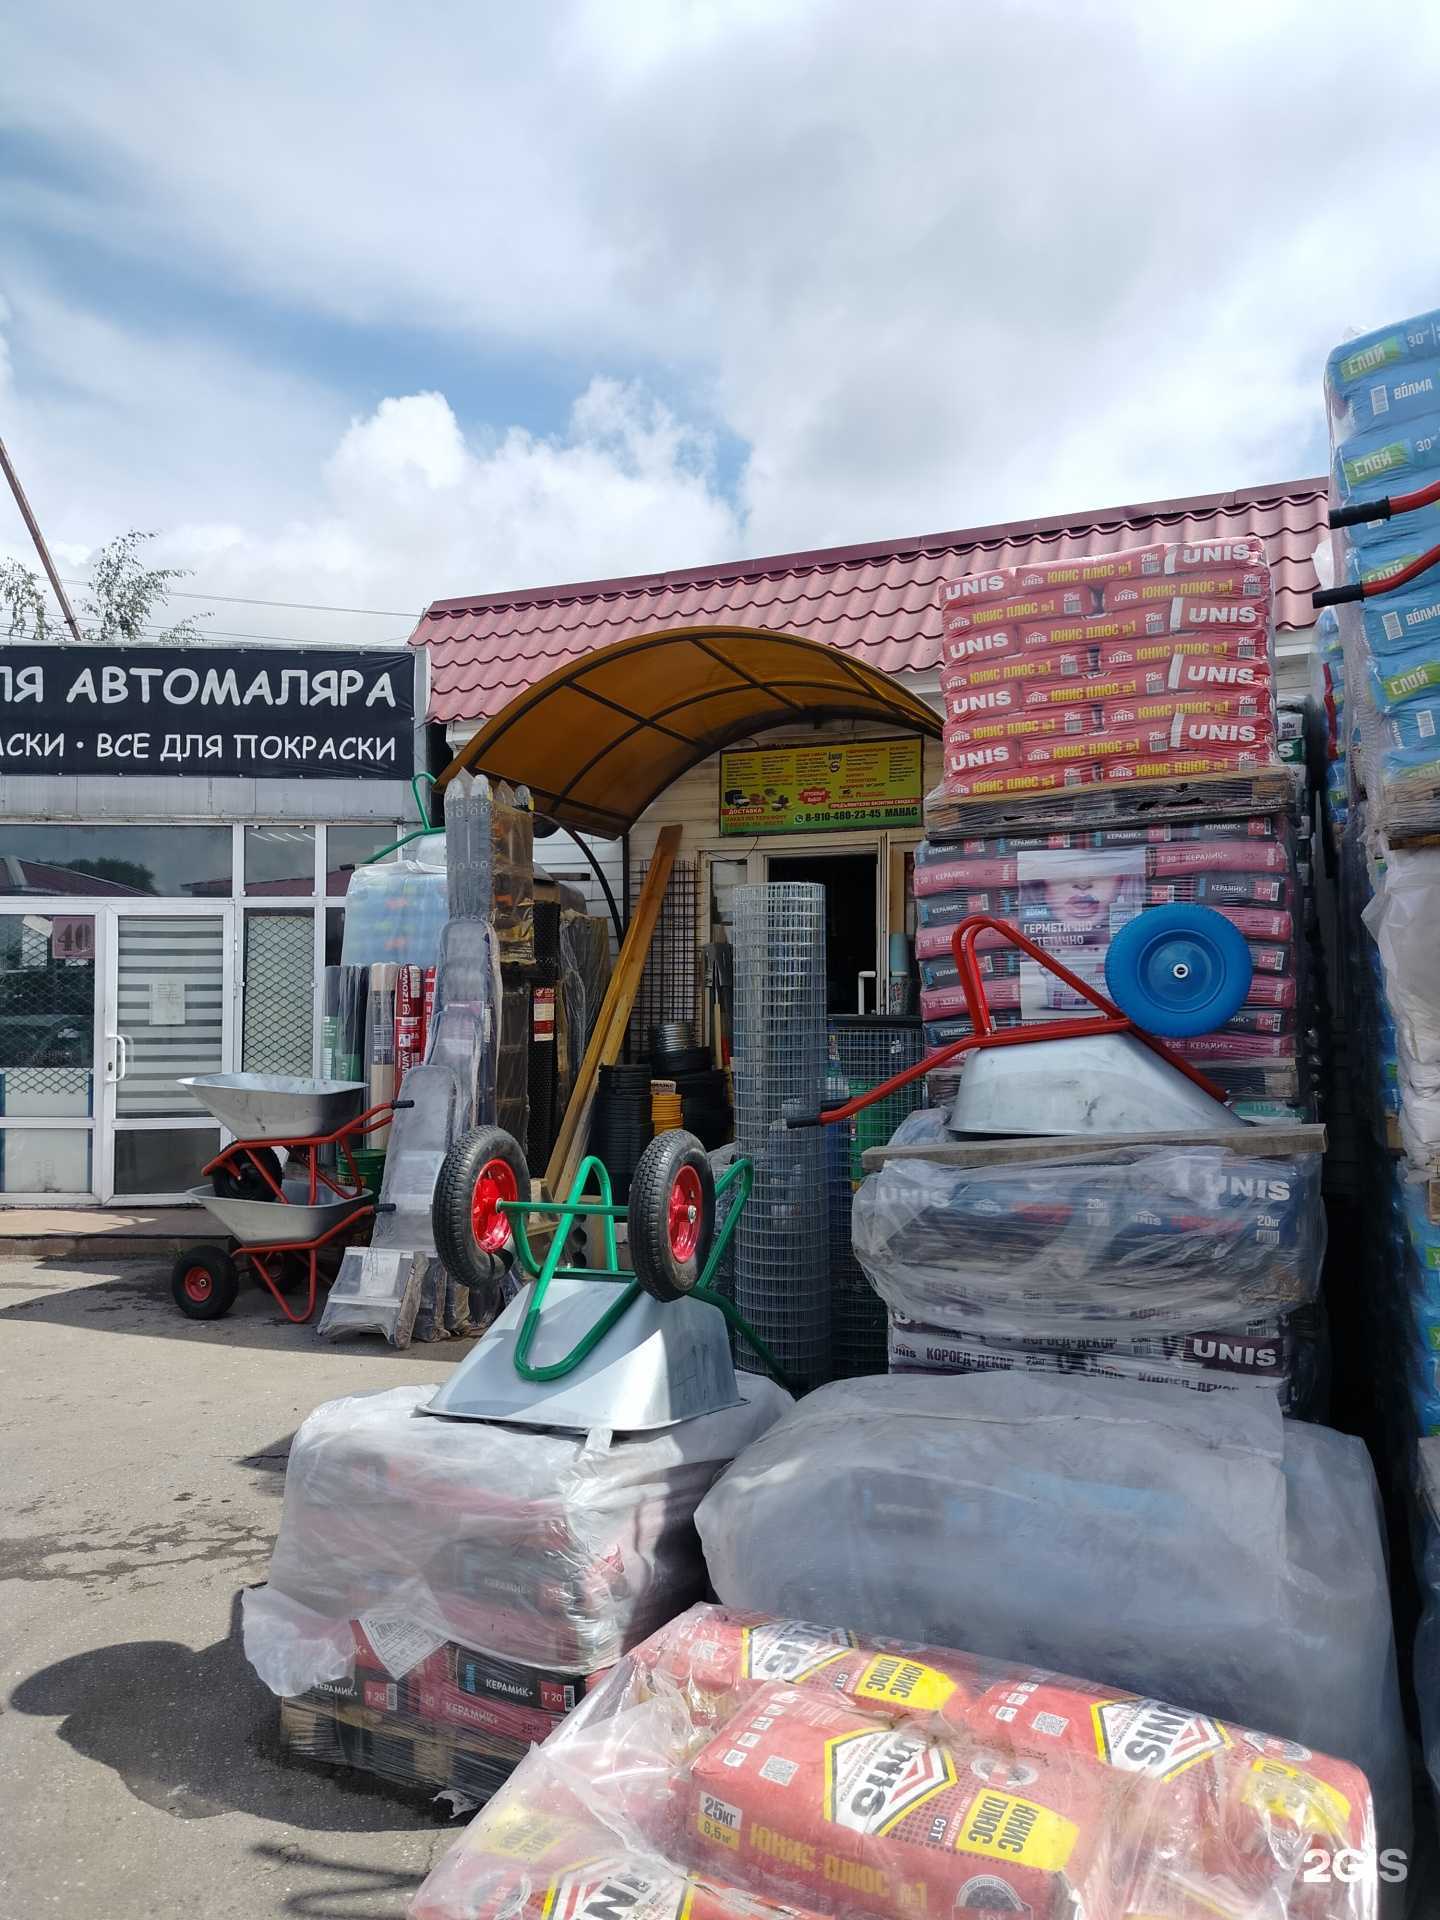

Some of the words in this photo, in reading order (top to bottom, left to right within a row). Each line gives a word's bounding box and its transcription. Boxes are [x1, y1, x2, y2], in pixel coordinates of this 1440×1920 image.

[1354, 450, 1393, 477] СЛОЙ
[1184, 544, 1250, 563] UNIS
[1048, 569, 1079, 583] ЮНИС
[946, 576, 1004, 600] UNIS
[1142, 585, 1176, 598] ЮНИС
[972, 609, 1003, 624] ЮНИС
[1189, 606, 1256, 623] UNIS
[1051, 628, 1082, 641] ЮНИС
[950, 632, 1009, 659] UNIS
[1136, 646, 1171, 661] ЮНИС
[970, 669, 1000, 685] ЮНИС
[1187, 666, 1254, 684] UNIS
[1391, 665, 1429, 696] СЛОЙ
[66, 666, 396, 707] АВТОМАЛЯРА
[1051, 687, 1083, 701] ЮНИС
[953, 691, 1011, 714] UNIS
[1138, 705, 1172, 720] ЮНИС
[974, 725, 1003, 739] ЮНИС
[1189, 724, 1256, 741] UNIS
[0, 733, 64, 757] СКИ
[97, 733, 151, 759] ВСЕ
[160, 734, 222, 762] ДЛЯ
[234, 735, 396, 761] ПОКРАСКИ
[951, 747, 1009, 771] UNIS
[885, 807, 918, 817] МАНАС
[1205, 823, 1241, 831] КЕРАМИК+
[1211, 885, 1247, 893] КЕРАМИК+
[1257, 1215, 1280, 1228] 20кг
[1193, 1338, 1276, 1367] UNIS
[866, 1658, 900, 1692] ПЛЮС
[889, 1664, 924, 1699] ЮНИС
[486, 1678, 534, 1697] КЕРАМИК+
[551, 1693, 562, 1703] 20
[703, 1796, 736, 1826] 25кг
[968, 1796, 1009, 1845] ПЛЮС
[998, 1804, 1040, 1854] ЮНИС
[751, 1823, 817, 1872] ЮНИС
[823, 1855, 891, 1897] ПЛЮС
